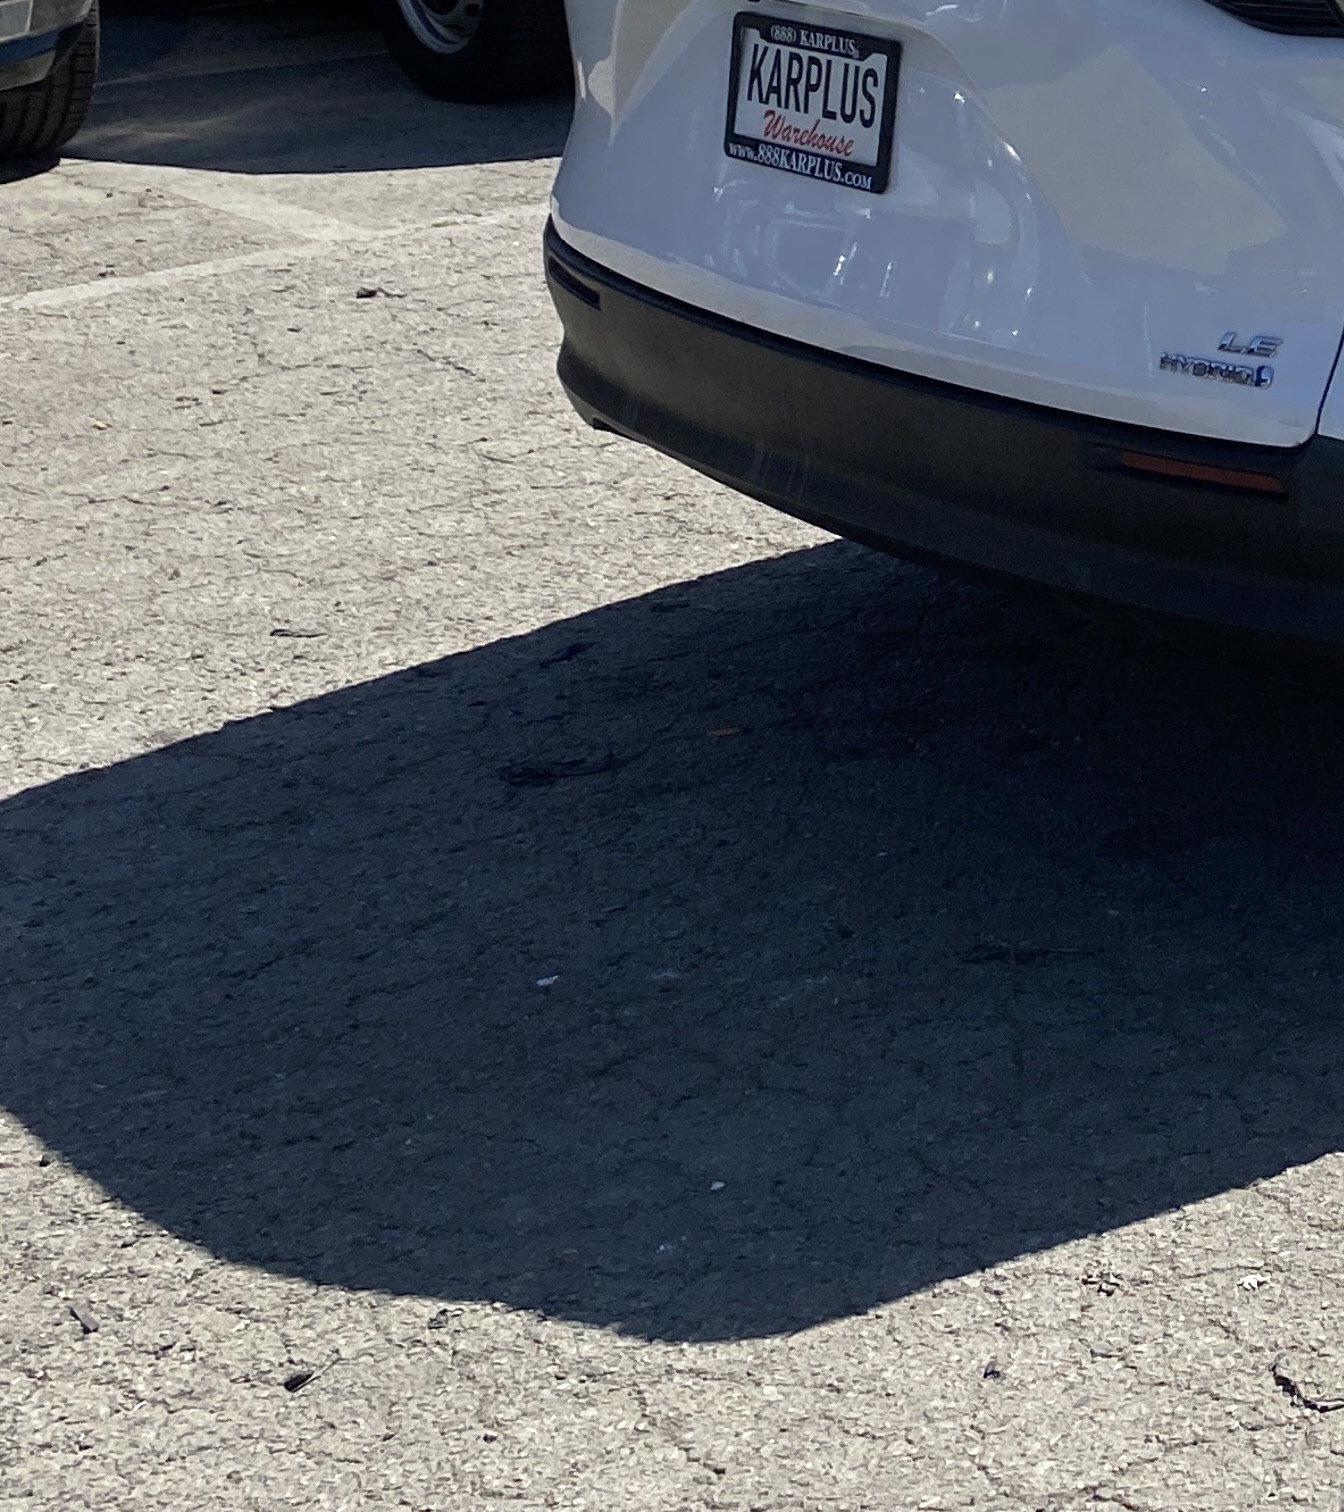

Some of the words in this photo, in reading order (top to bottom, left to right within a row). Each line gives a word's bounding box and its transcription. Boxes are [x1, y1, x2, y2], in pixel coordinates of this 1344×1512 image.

[800, 30, 857, 55] KARPLUS
[747, 43, 879, 129] KARPLUS
[763, 109, 854, 157] Warehouse
[1217, 331, 1284, 358] LE
